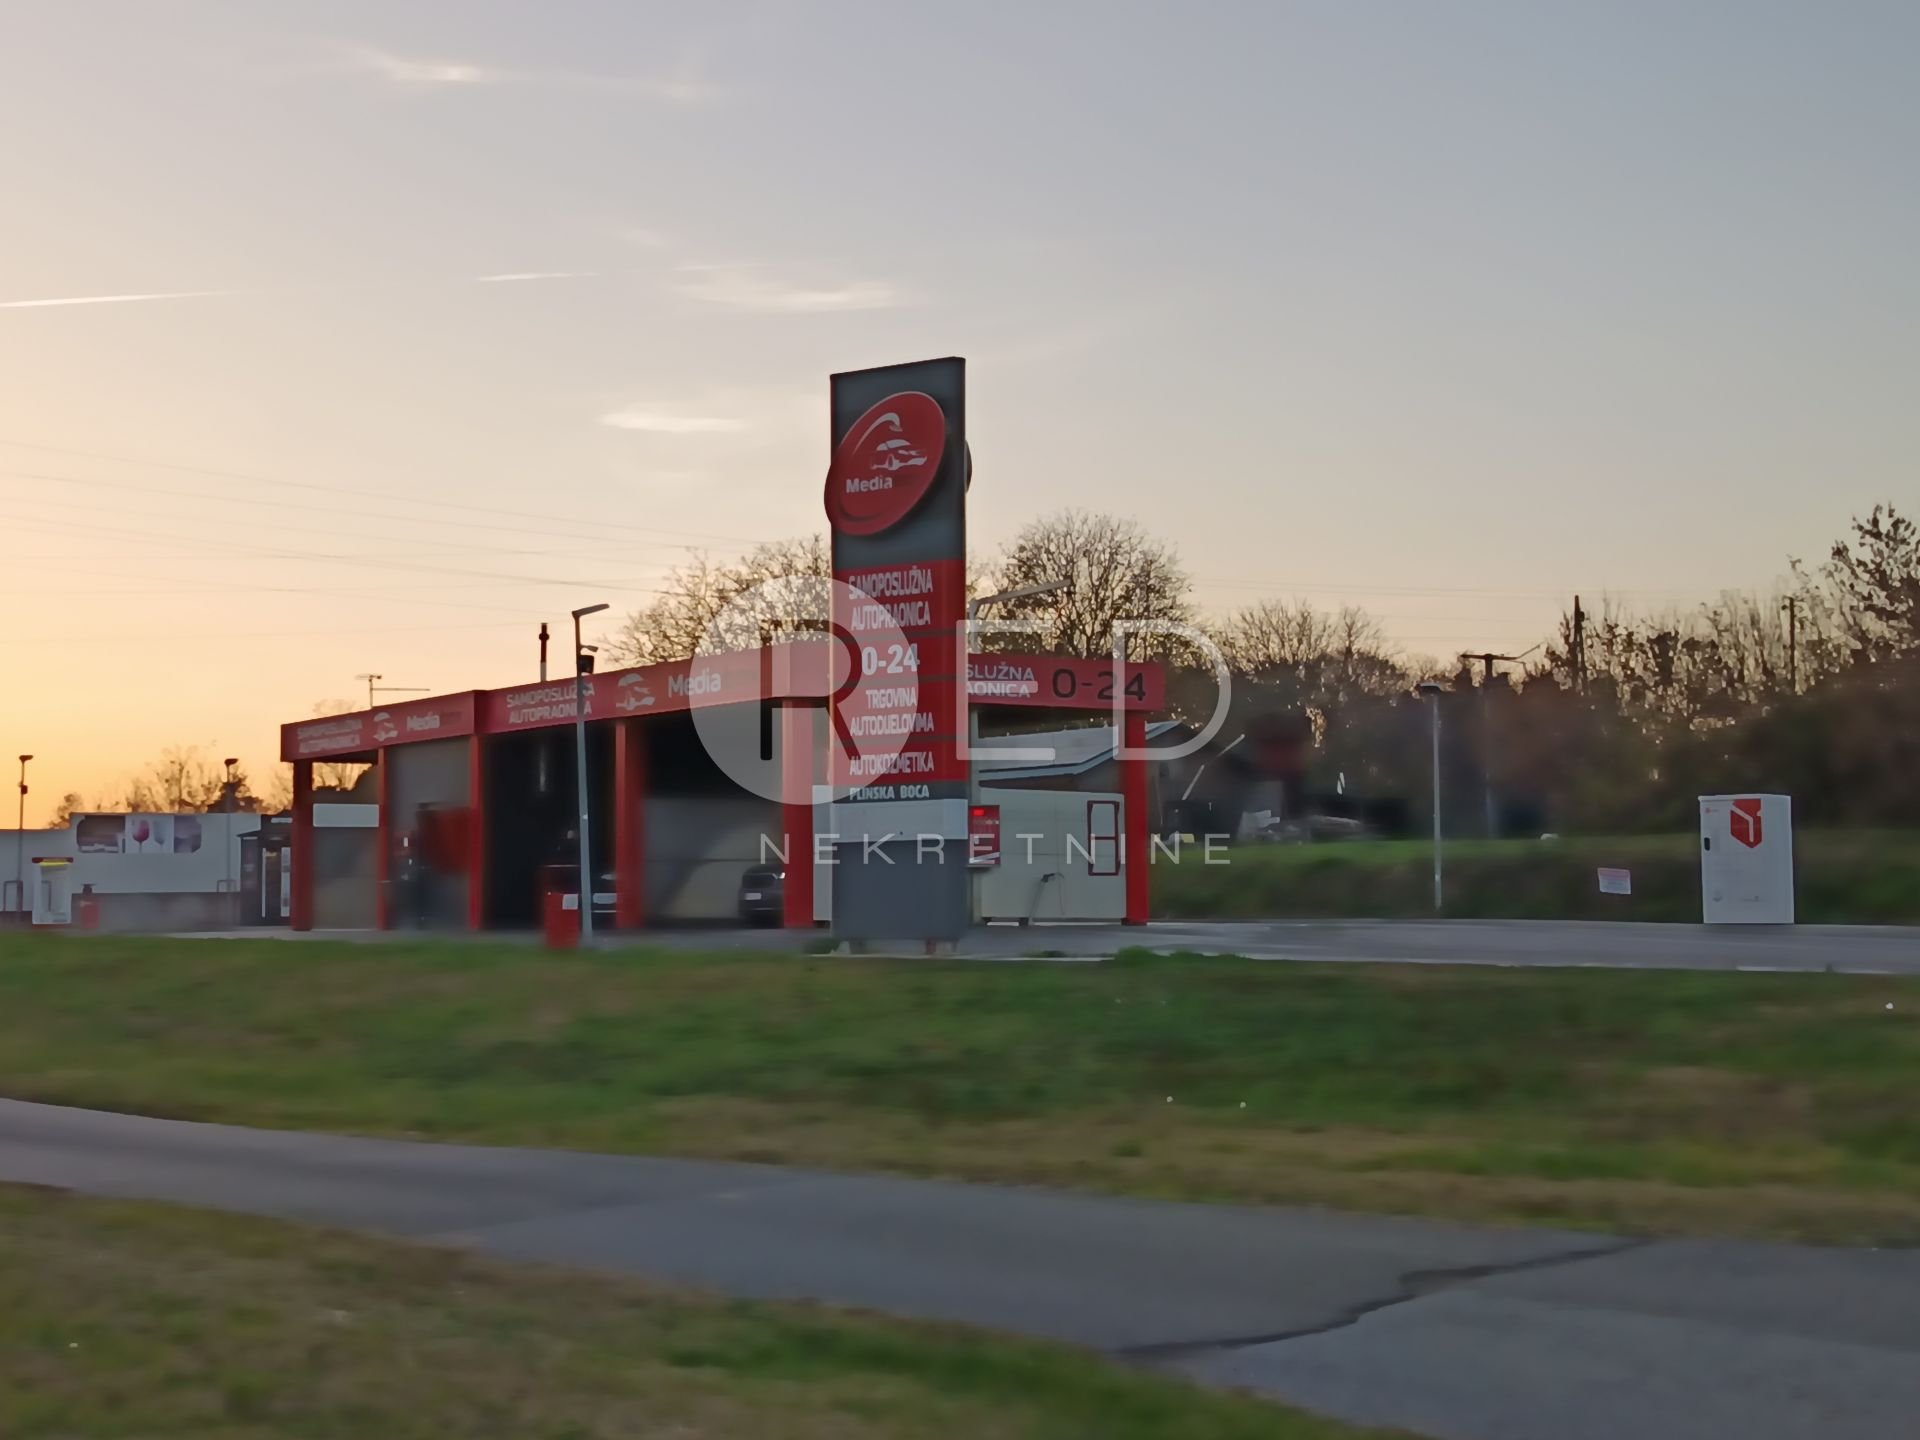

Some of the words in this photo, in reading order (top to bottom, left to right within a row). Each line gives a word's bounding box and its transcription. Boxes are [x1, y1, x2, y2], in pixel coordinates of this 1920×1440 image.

[845, 475, 893, 493] Media
[848, 565, 934, 600] SAMOPOSLUŽNA
[851, 601, 931, 631] AUTOPRAONICA
[861, 643, 921, 676] 0-24
[667, 667, 722, 698] Media
[1052, 668, 1146, 702] 0-24
[508, 700, 593, 725] AUTOPRAONIA
[865, 687, 918, 710] TRGOVINA
[849, 751, 935, 777] AUTOKOZMETIKA
[900, 784, 930, 799] BOCA
